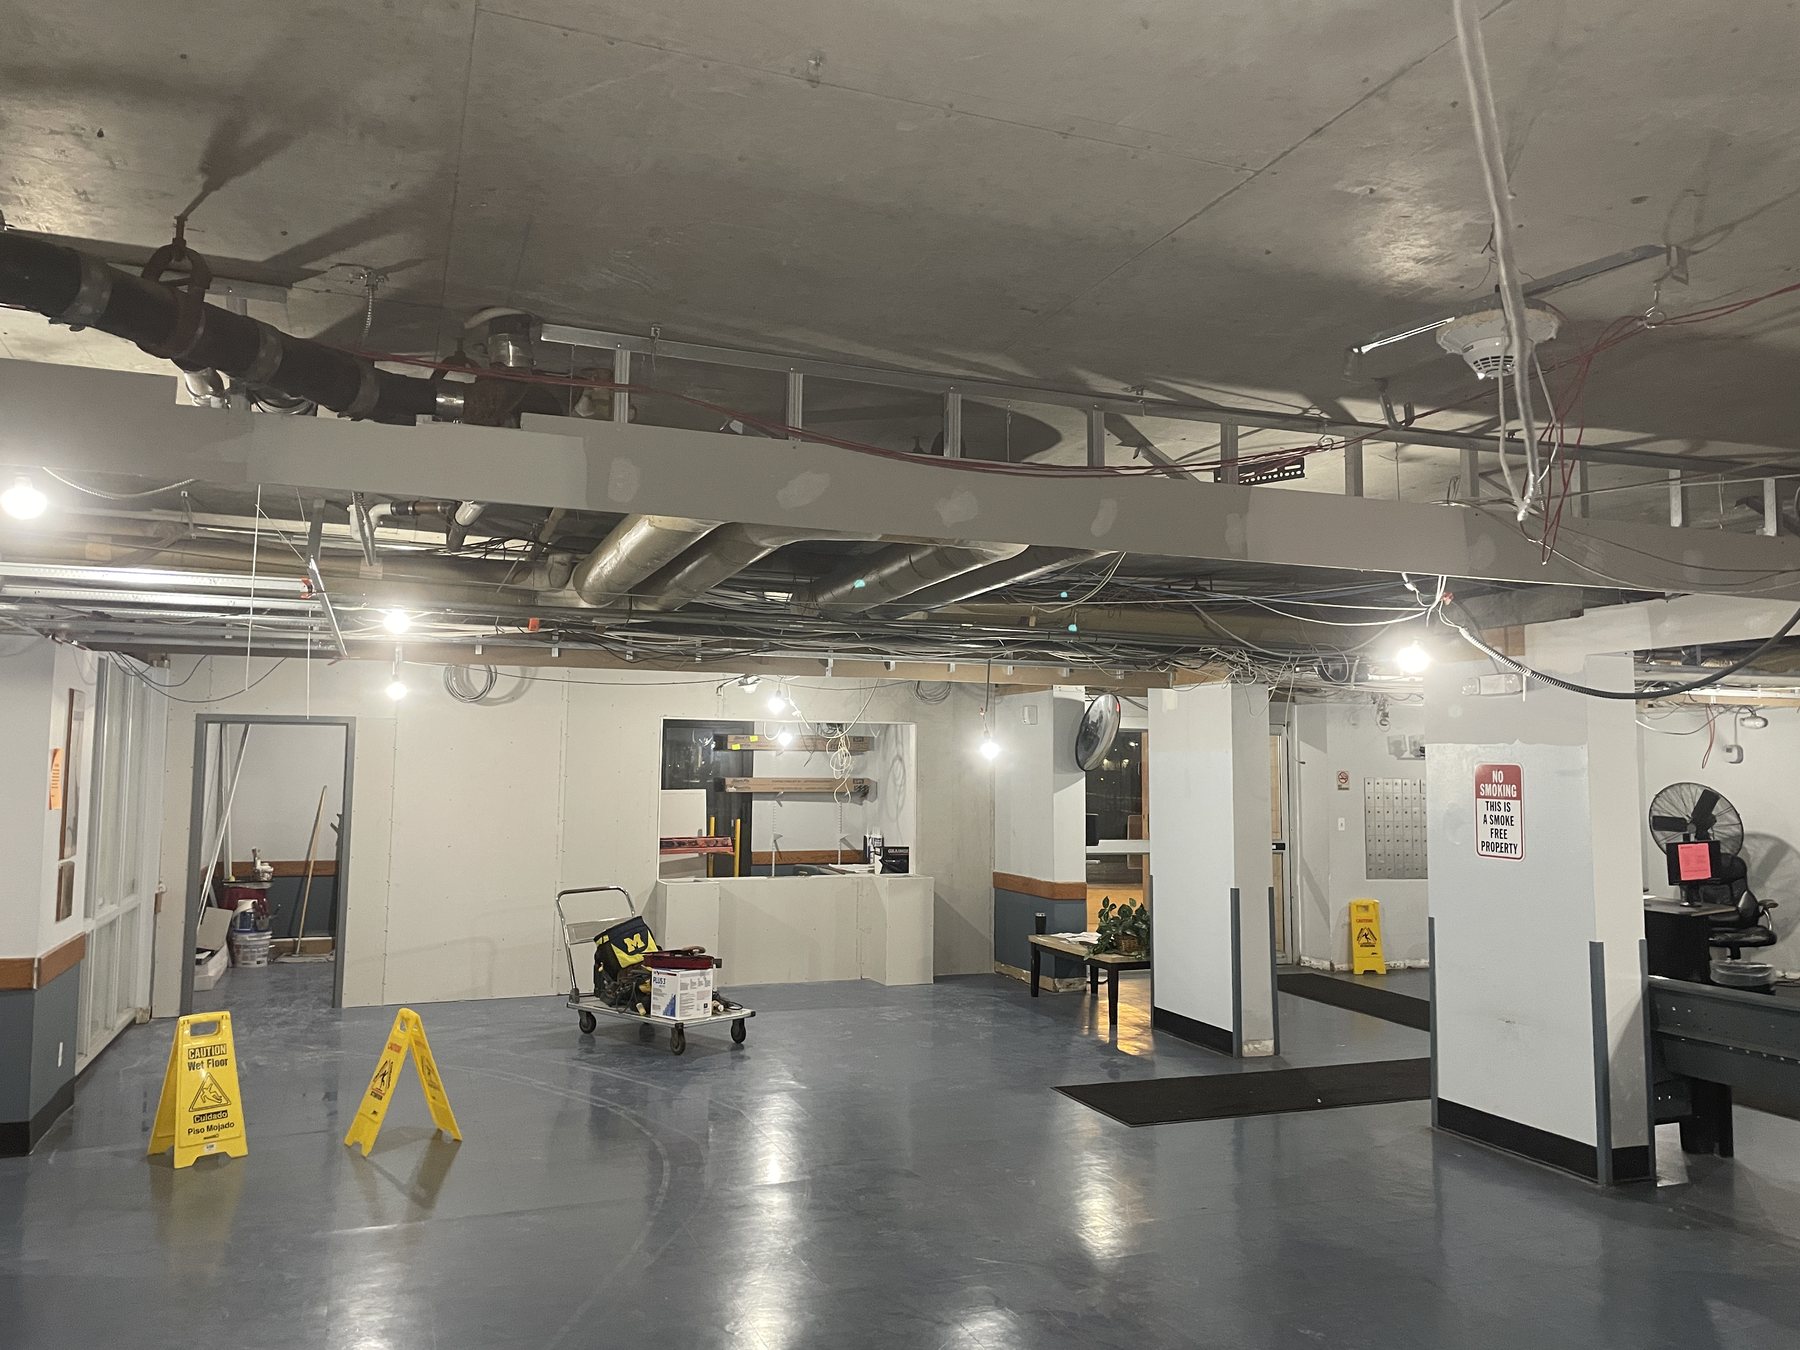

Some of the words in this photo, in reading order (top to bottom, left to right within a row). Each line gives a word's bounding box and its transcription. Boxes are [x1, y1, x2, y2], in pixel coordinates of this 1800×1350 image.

[1492, 770, 1504, 783] NO
[1480, 784, 1517, 797] SMOKING
[1485, 801, 1502, 812] THIS
[1503, 802, 1511, 813] IS
[1483, 814, 1488, 825] A
[1489, 815, 1514, 826] SMOKE
[1490, 828, 1507, 839] FREE
[1481, 841, 1518, 854] PROPERTY
[624, 933, 645, 952] M
[188, 1045, 227, 1059] CAUTION
[187, 1060, 204, 1071] Wet
[206, 1058, 228, 1069] Floor
[194, 1111, 228, 1123] Cuidado
[187, 1127, 205, 1136] Piso
[206, 1122, 235, 1132] Mojado
